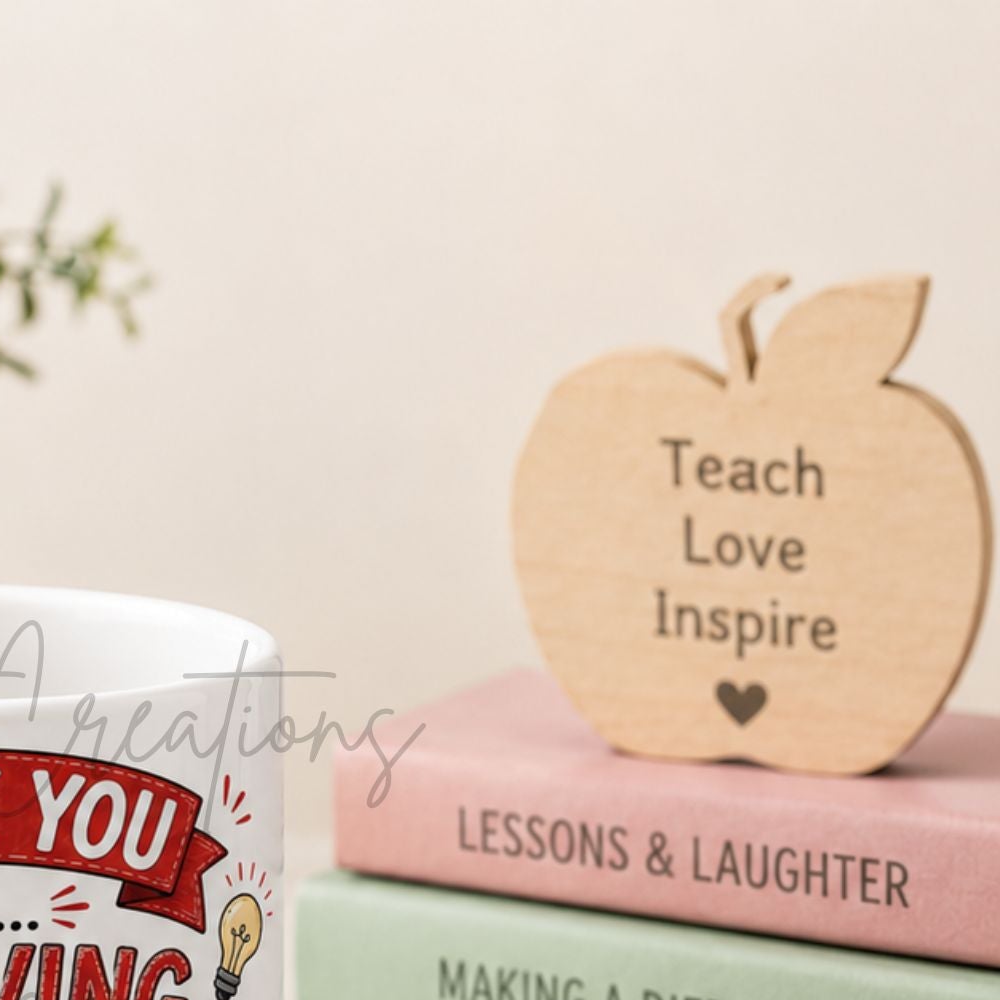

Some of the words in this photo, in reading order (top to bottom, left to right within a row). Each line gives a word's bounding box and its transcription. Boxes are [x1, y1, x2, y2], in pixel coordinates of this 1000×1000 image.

[659, 437, 825, 498] Teach
[681, 515, 808, 571] Love
[653, 589, 839, 659] Inspire
[32, 768, 178, 873] YOU
[458, 807, 630, 871] LESSONS
[645, 830, 676, 878] &
[689, 835, 911, 910] LAUGHTER
